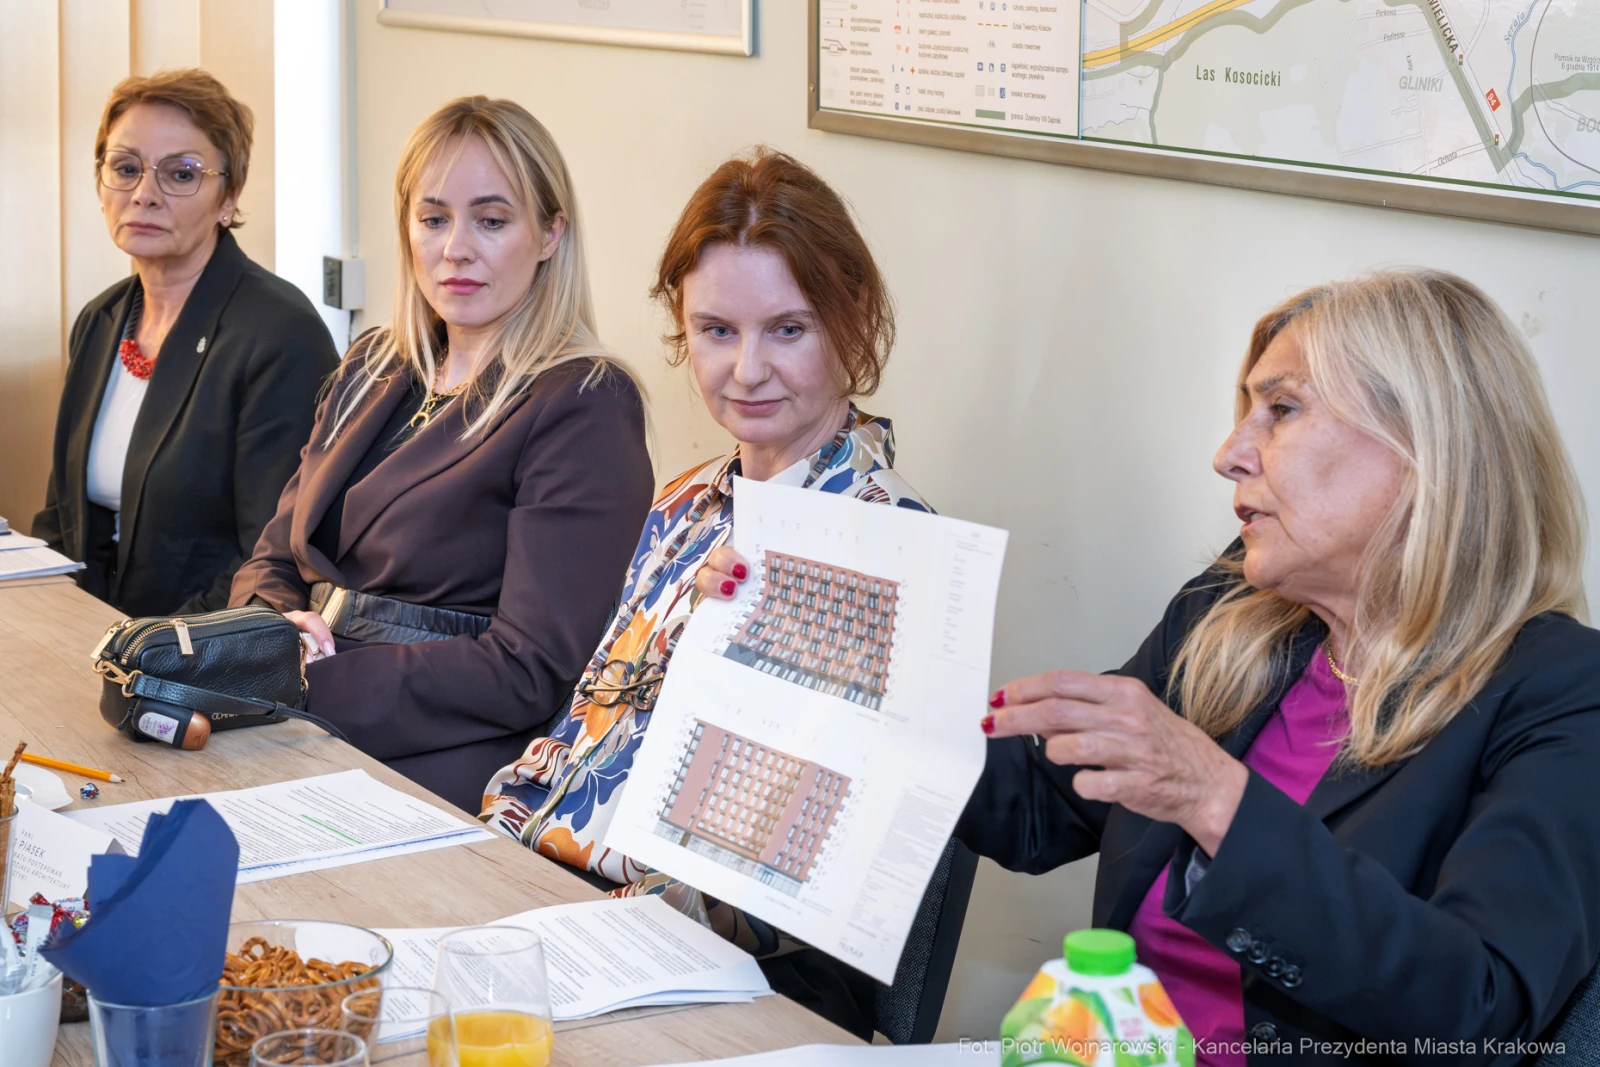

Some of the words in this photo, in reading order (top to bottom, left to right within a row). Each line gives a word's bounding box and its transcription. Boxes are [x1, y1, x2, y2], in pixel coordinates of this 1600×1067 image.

[1555, 53, 1573, 62] Pomnik
[1562, 62, 1566, 70] 6
[1566, 63, 1585, 71] grudnia
[1196, 64, 1216, 81] Las
[1225, 66, 1281, 87] Kosocicki
[1398, 75, 1444, 93] GLINIKI
[1487, 93, 1497, 107] 94
[21, 829, 34, 840] PANI
[18, 840, 46, 859] PIASEK
[31, 869, 72, 891] ARCHITEKTURY
